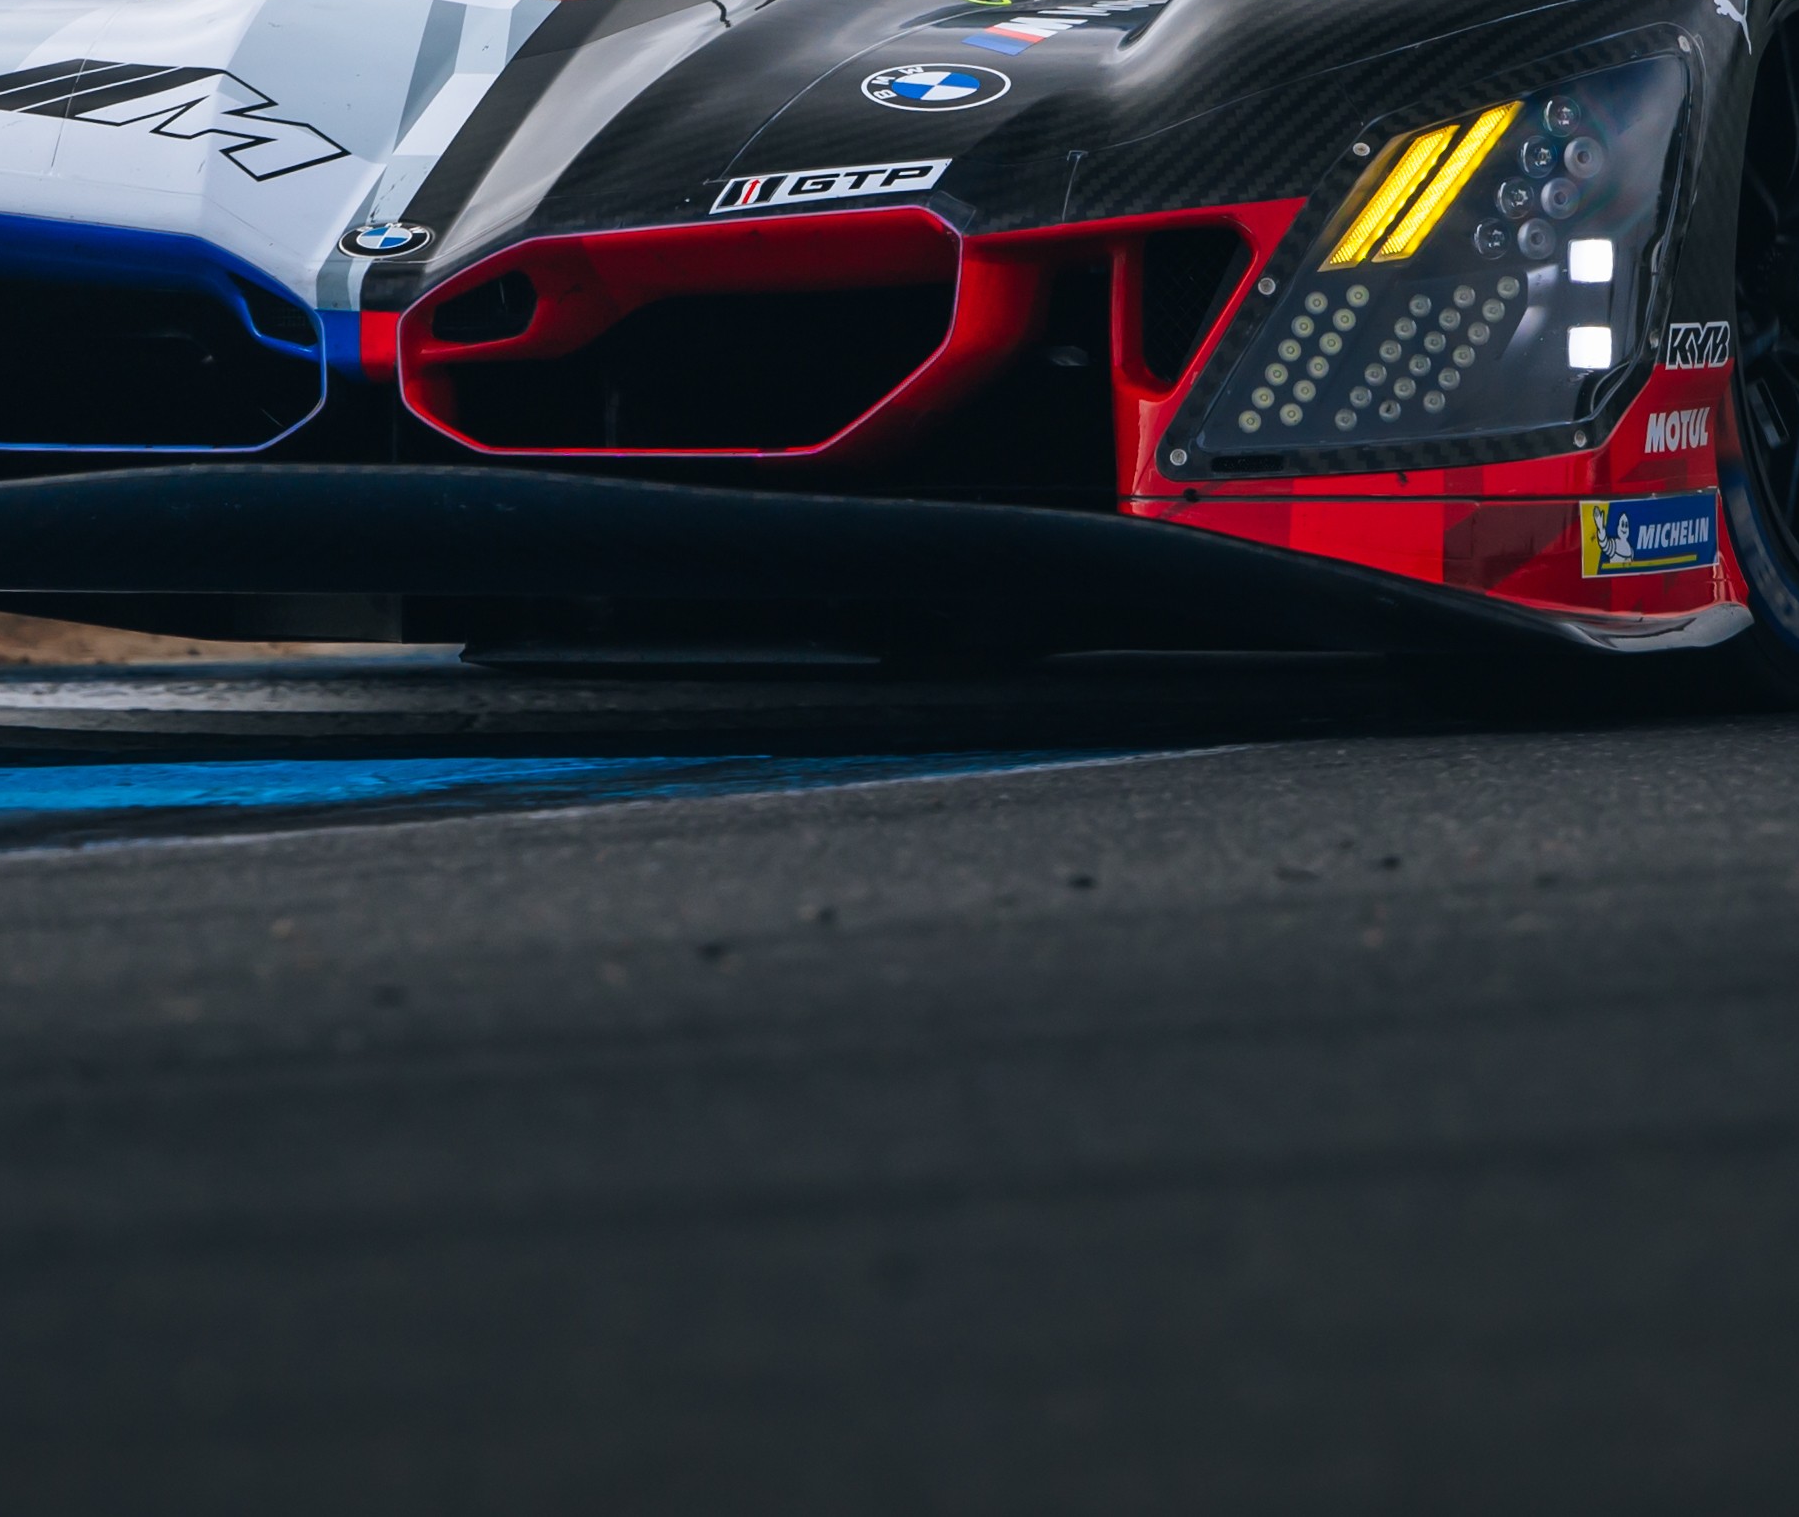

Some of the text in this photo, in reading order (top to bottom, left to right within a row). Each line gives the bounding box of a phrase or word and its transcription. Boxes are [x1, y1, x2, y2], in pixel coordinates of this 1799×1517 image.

[788, 166, 934, 196] GTP
[1665, 321, 1731, 371] KYB
[1644, 407, 1711, 454] MOTUL
[1636, 516, 1710, 550] MICHELIN
